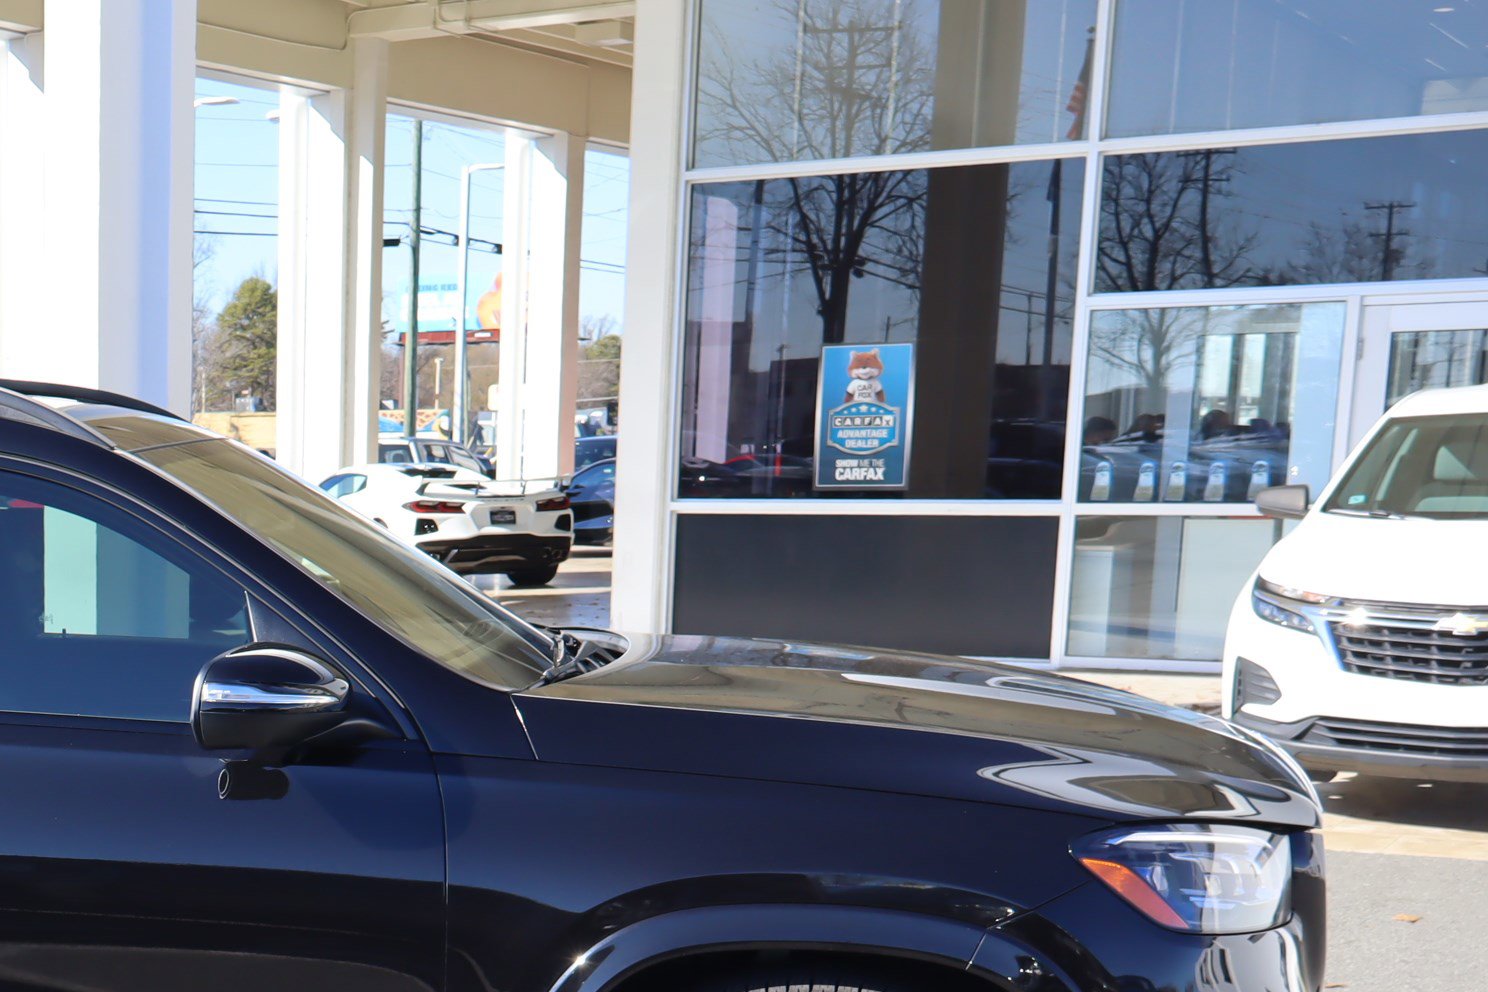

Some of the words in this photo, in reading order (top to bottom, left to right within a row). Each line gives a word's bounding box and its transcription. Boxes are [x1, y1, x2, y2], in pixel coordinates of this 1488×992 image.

[834, 415, 893, 427] CARFAX
[837, 429, 888, 438] ADVANTAGE
[845, 439, 879, 448] DEALER
[835, 459, 858, 467] SHOW
[872, 459, 885, 467] THE
[835, 467, 885, 481] CARFAX
